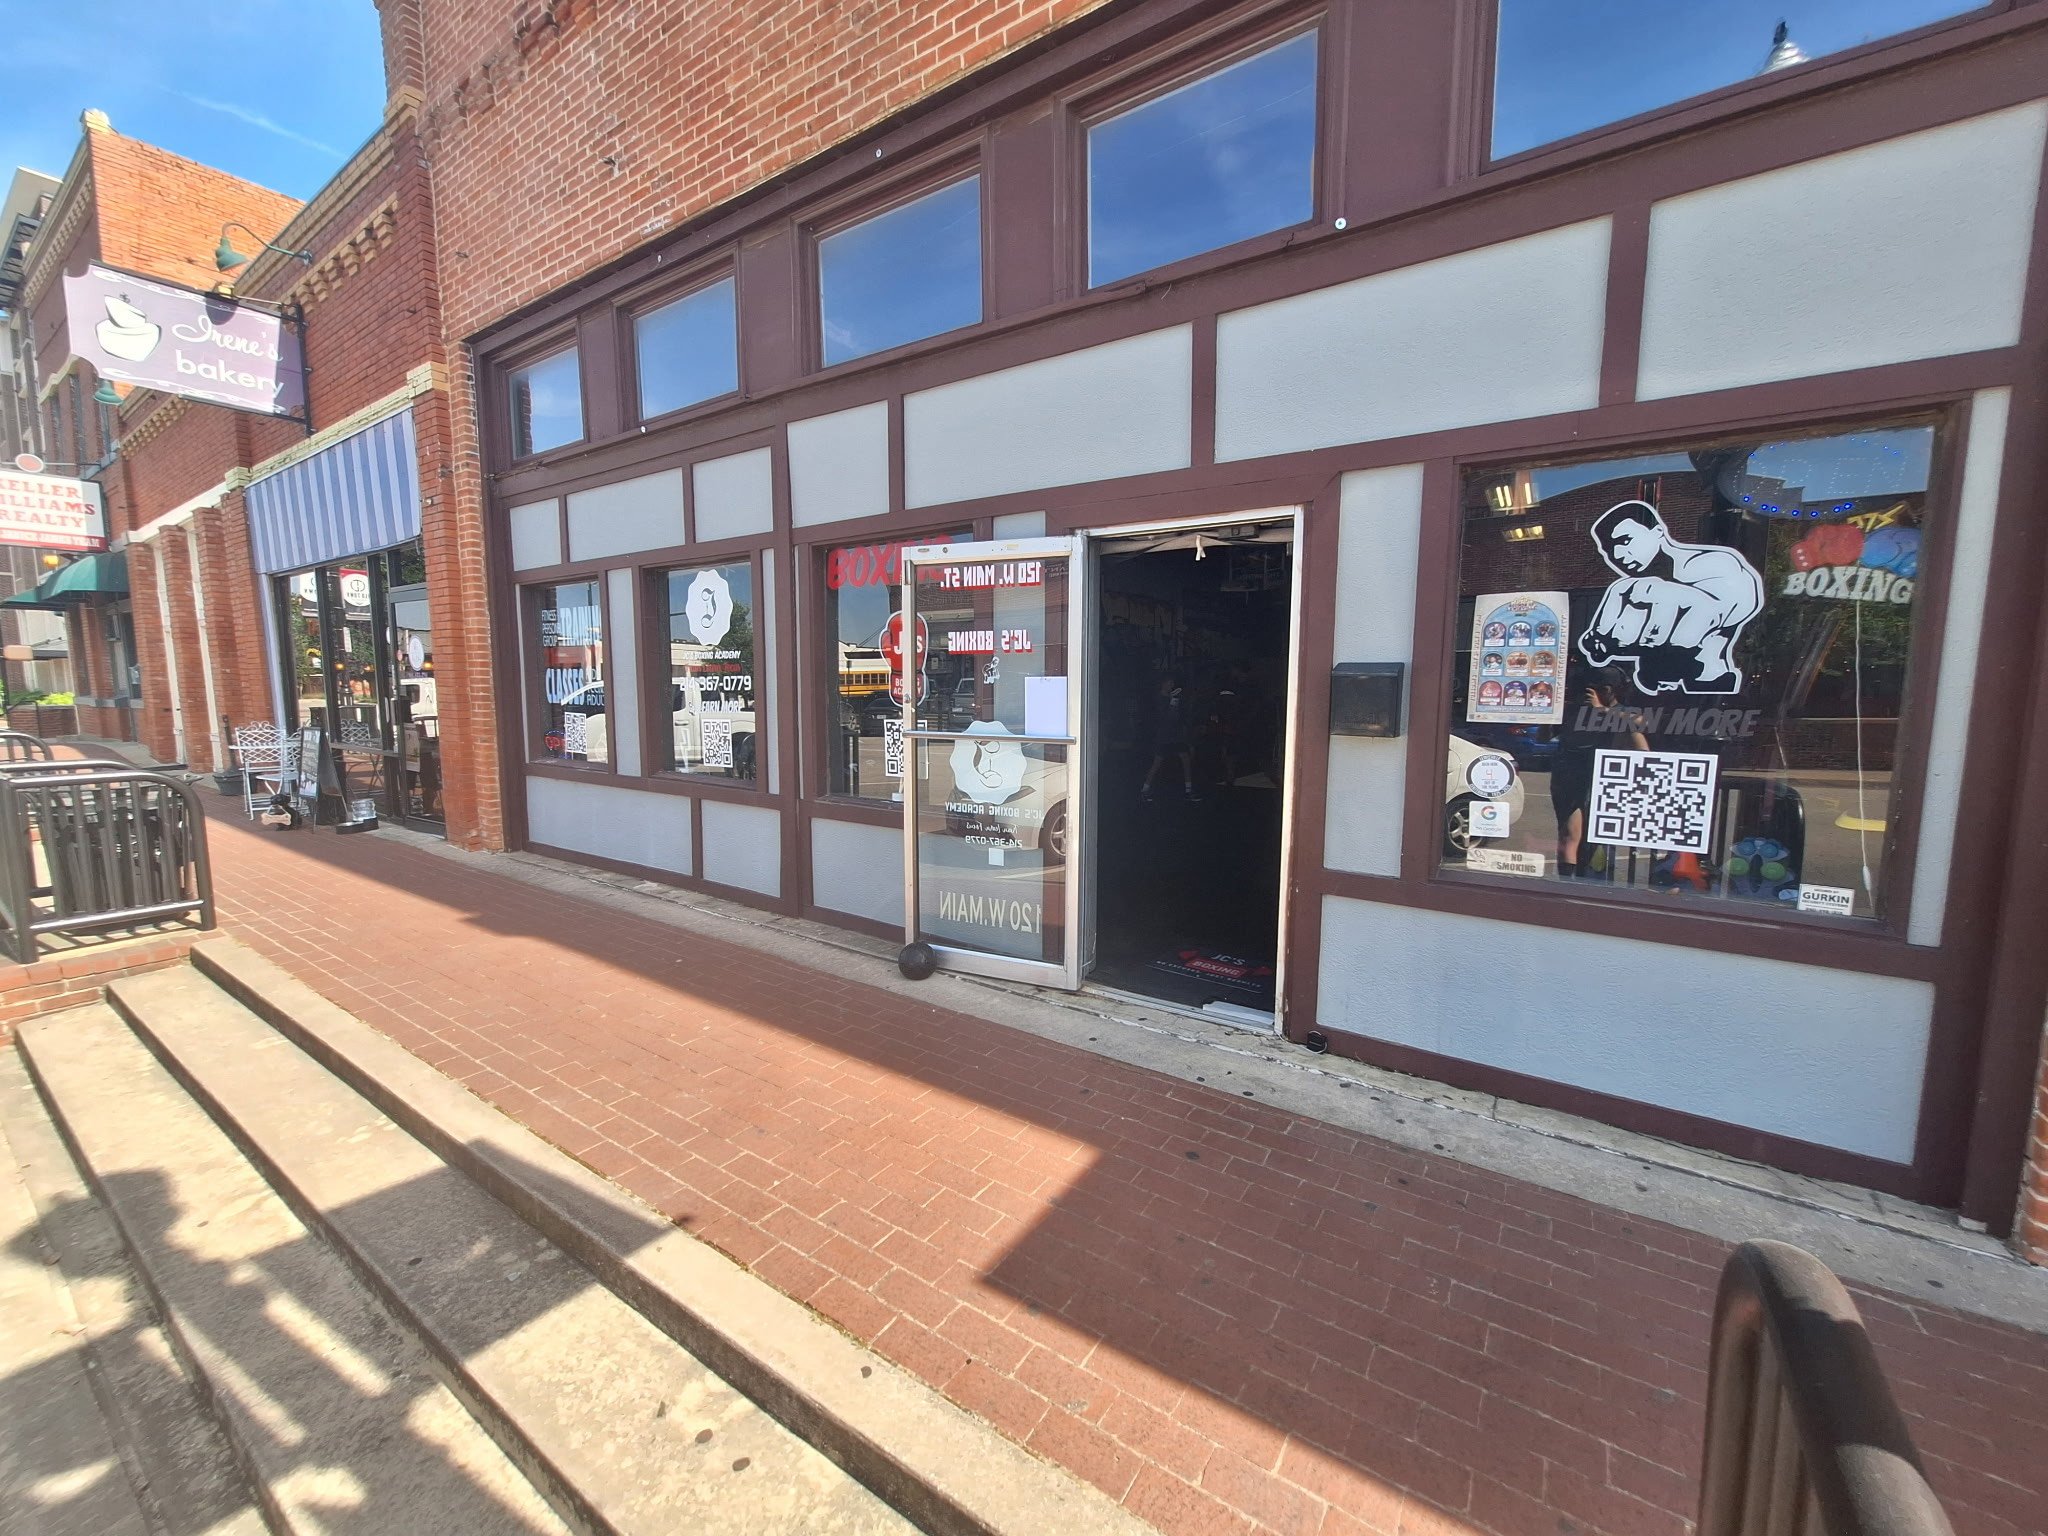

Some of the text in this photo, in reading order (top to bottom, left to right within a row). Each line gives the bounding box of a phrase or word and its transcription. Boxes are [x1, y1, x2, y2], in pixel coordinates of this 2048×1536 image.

[171, 314, 284, 362] Irene's
[175, 349, 285, 399] bakery
[0, 493, 96, 516] ILLIAMS
[1782, 565, 1917, 604] BOXING
[559, 604, 602, 647] TRAININ
[714, 650, 742, 660] ACADEMY
[545, 667, 585, 705] CLASSES
[679, 675, 753, 692] 214367-0779
[586, 695, 605, 706] ADUL
[699, 700, 721, 713] EARN
[1573, 705, 1762, 737] LEARN MORE
[1510, 853, 1523, 862] NO
[1496, 861, 1537, 874] SMOKING
[1802, 891, 1850, 904] GURKIN
[1191, 960, 1242, 976] BOXING
[1210, 953, 1246, 967] JC'S
